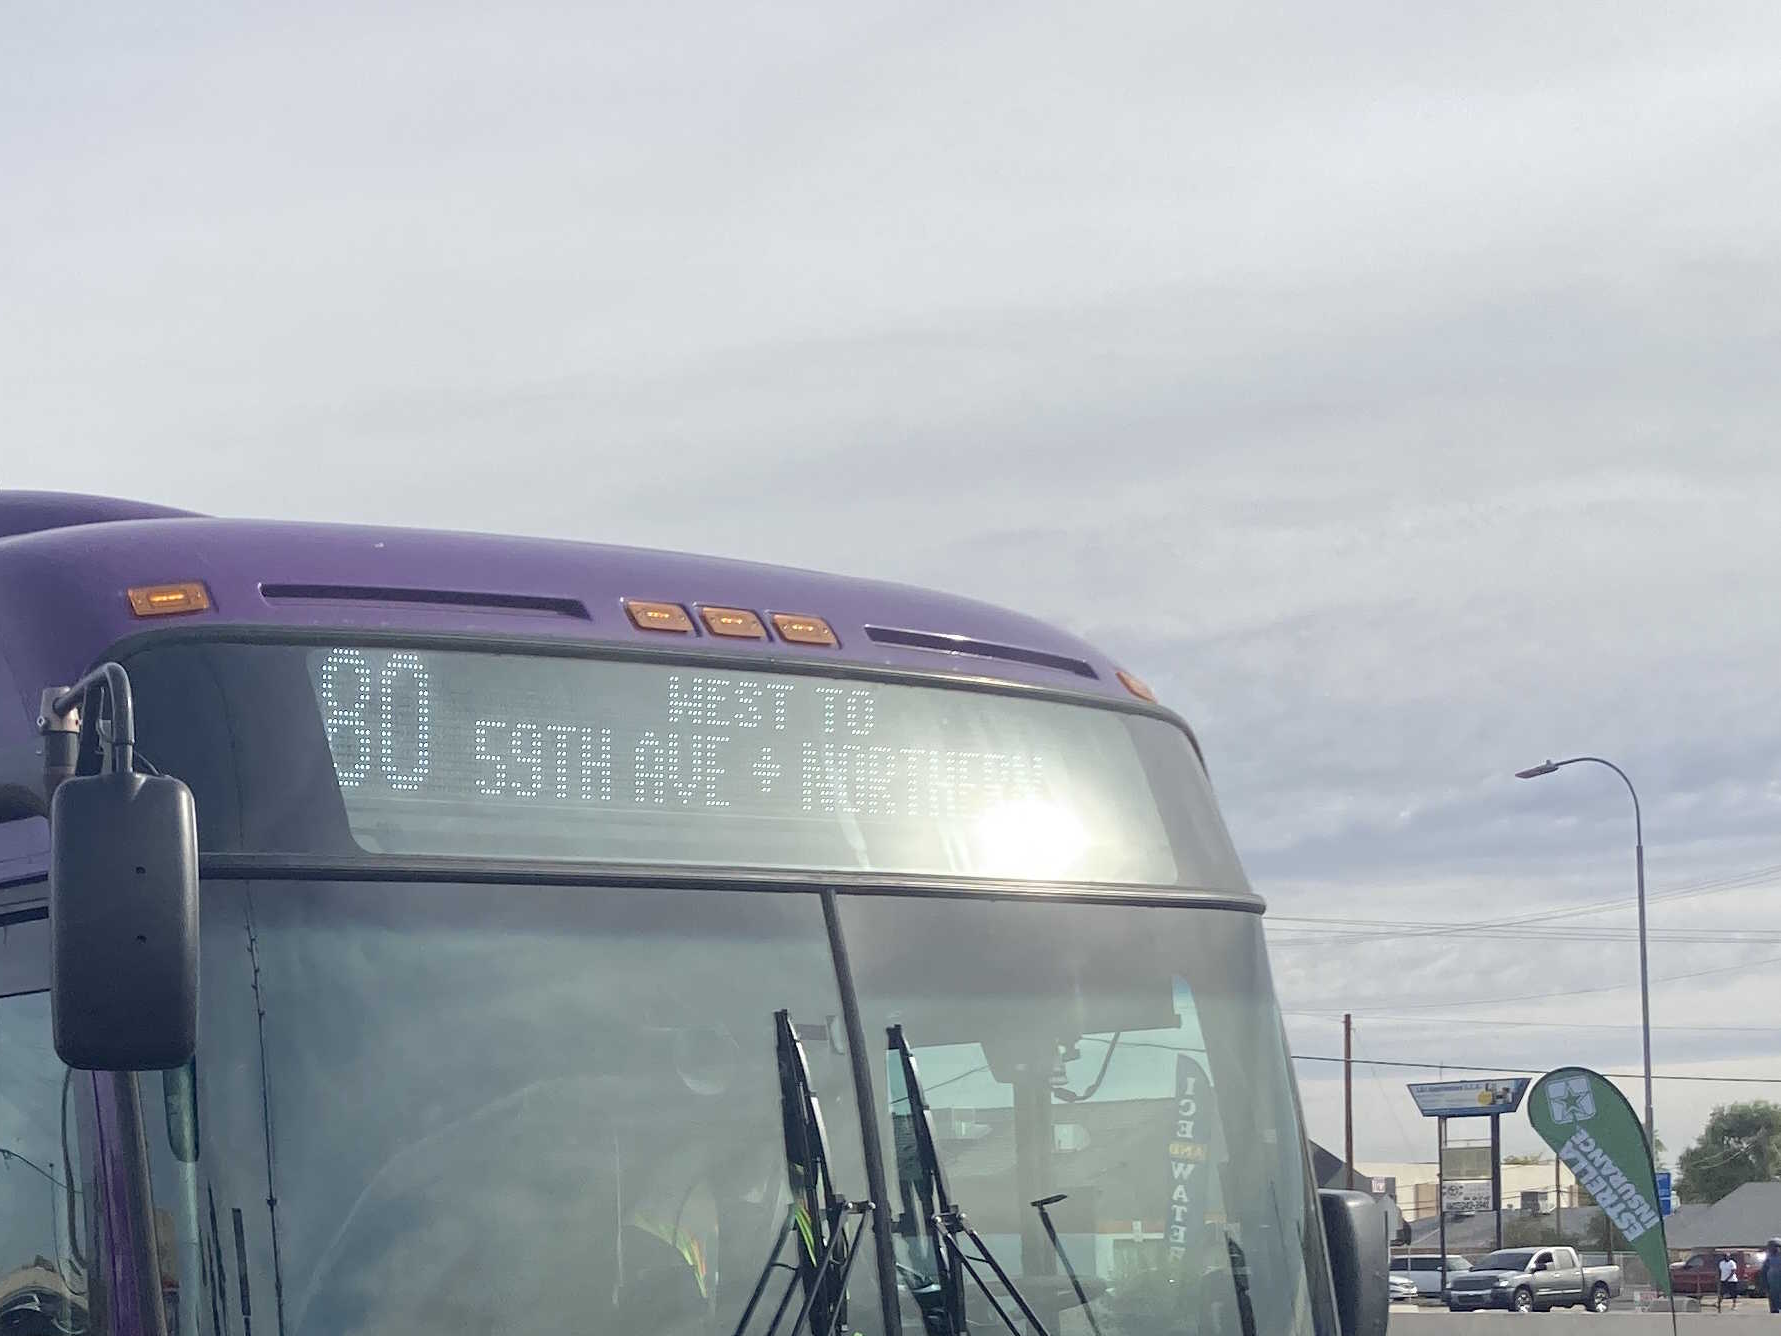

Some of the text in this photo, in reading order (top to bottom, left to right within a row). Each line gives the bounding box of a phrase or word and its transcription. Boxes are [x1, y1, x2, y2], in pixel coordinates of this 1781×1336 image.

[321, 647, 429, 791] 80
[668, 675, 875, 736] WEST TO
[474, 719, 612, 801] 59TH
[634, 731, 732, 807] AVE
[751, 745, 782, 793] +
[1560, 1140, 1645, 1242] ESTRELLA
[1570, 1125, 1660, 1229] INSURANCE
